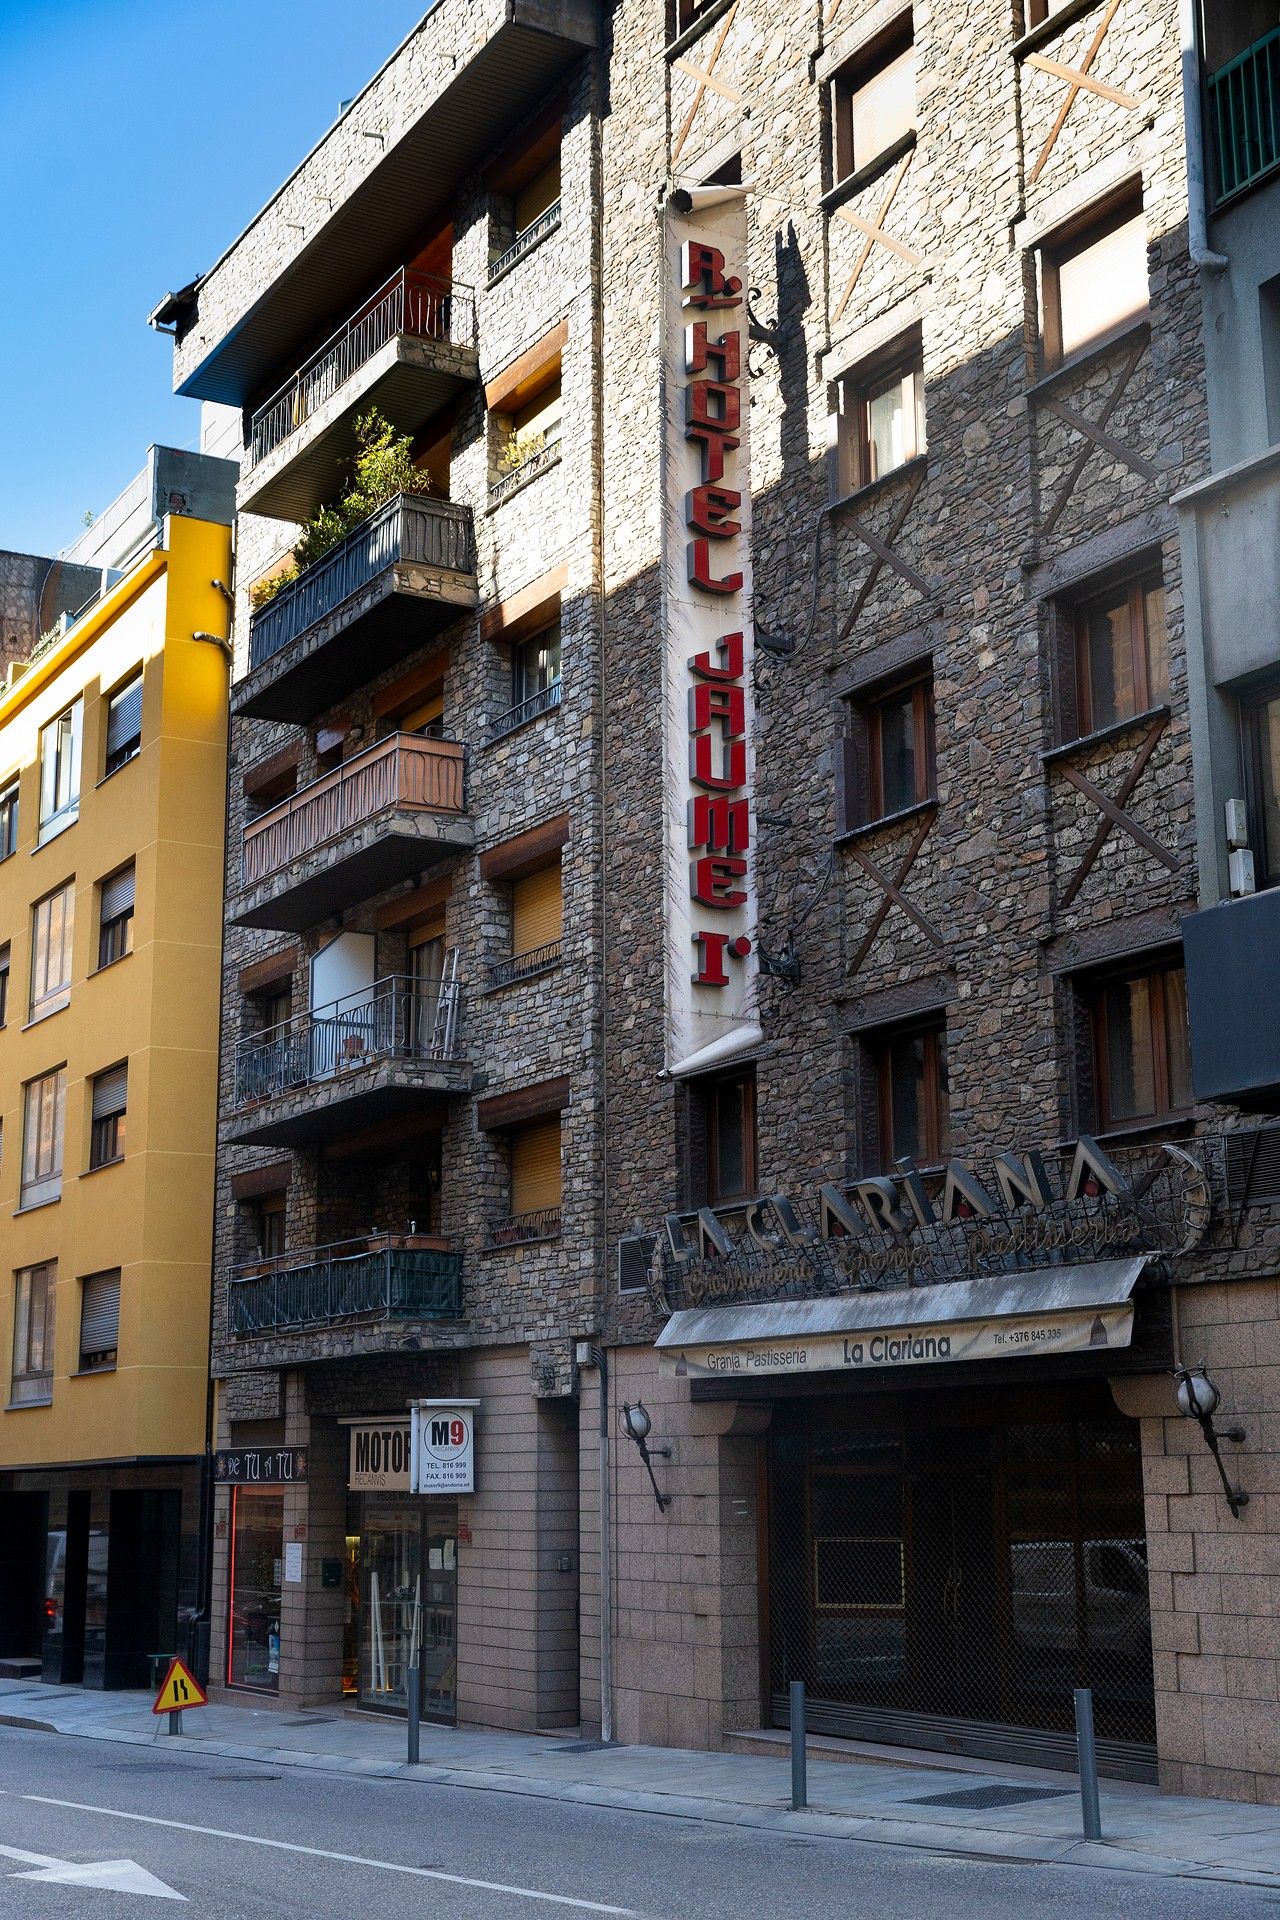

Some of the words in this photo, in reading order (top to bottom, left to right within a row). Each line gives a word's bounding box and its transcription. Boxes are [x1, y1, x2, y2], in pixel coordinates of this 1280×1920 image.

[685, 320, 744, 596] HOTEL
[687, 630, 749, 911] JAUME
[665, 1206, 737, 1263] LA
[745, 1134, 1133, 1251] CLARIANA
[843, 1338, 865, 1364] La
[869, 1333, 951, 1362] Clariana
[994, 1333, 1007, 1344] Tel.
[1009, 1331, 1029, 1343] +376
[1031, 1329, 1046, 1341] 845
[1047, 1328, 1061, 1340] 335
[707, 1353, 741, 1372] Granja
[746, 1346, 807, 1369] Pastisseria
[431, 1420, 464, 1446] M9
[244, 1452, 260, 1480] TU
[276, 1450, 293, 1479] TU
[426, 1462, 441, 1470] TEL.
[442, 1461, 454, 1469] 816
[426, 1472, 441, 1480] FAX.
[442, 1472, 454, 1480] 816
[354, 1473, 386, 1487] RECANVIS
